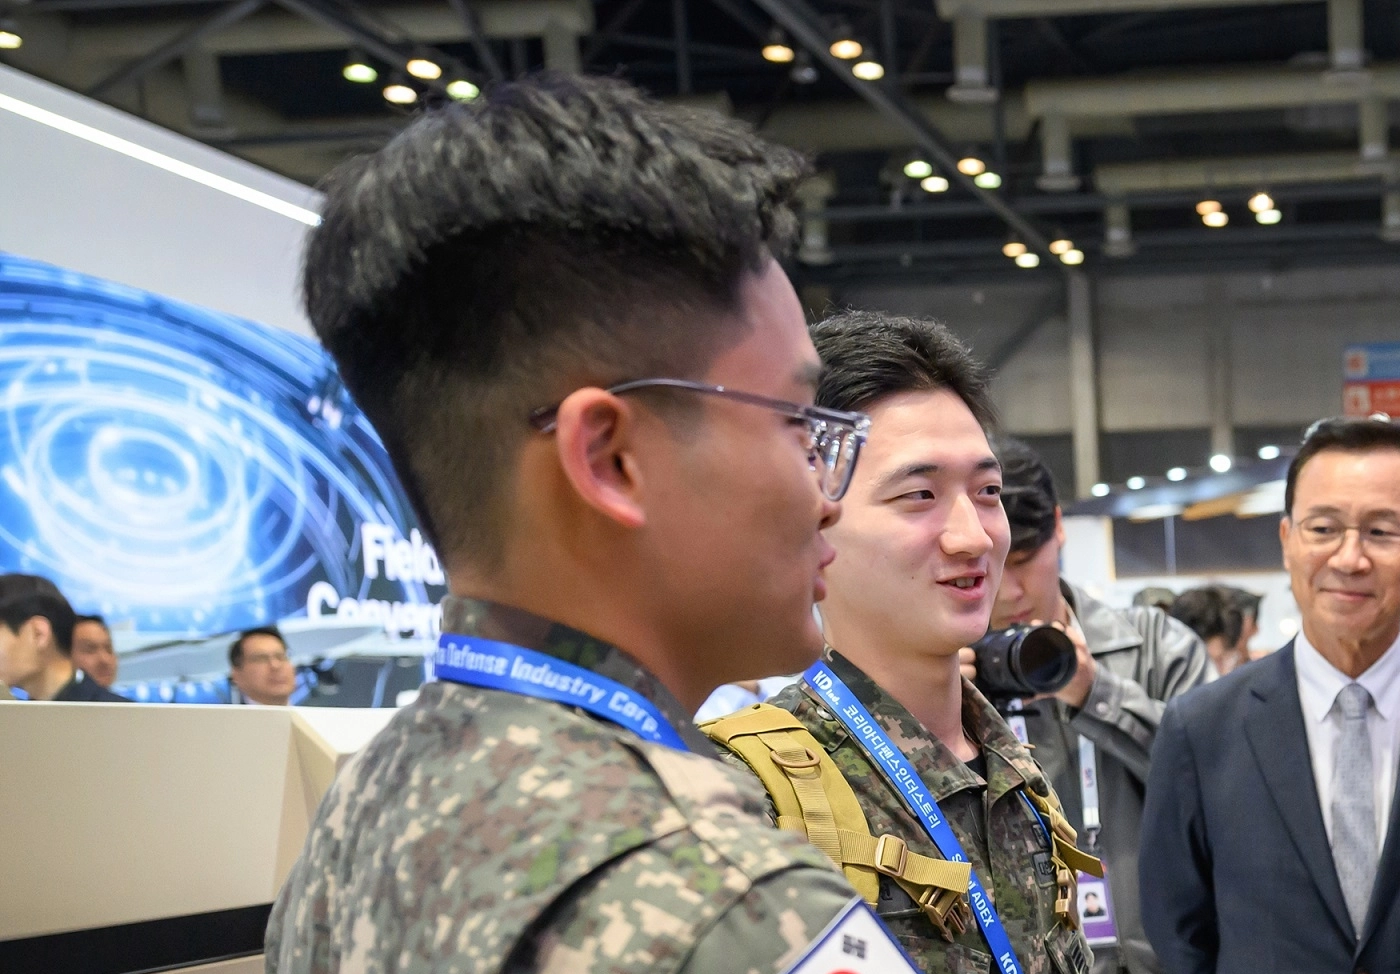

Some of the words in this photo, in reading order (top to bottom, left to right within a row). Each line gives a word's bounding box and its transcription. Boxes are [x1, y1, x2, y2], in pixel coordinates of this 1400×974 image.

[447, 642, 509, 676] Defense
[510, 655, 607, 704] Industry
[608, 690, 663, 740] Corp.
[812, 670, 834, 691] KD
[843, 704, 941, 829] 코리아디펜스인더스트리
[971, 892, 995, 928] ADEX
